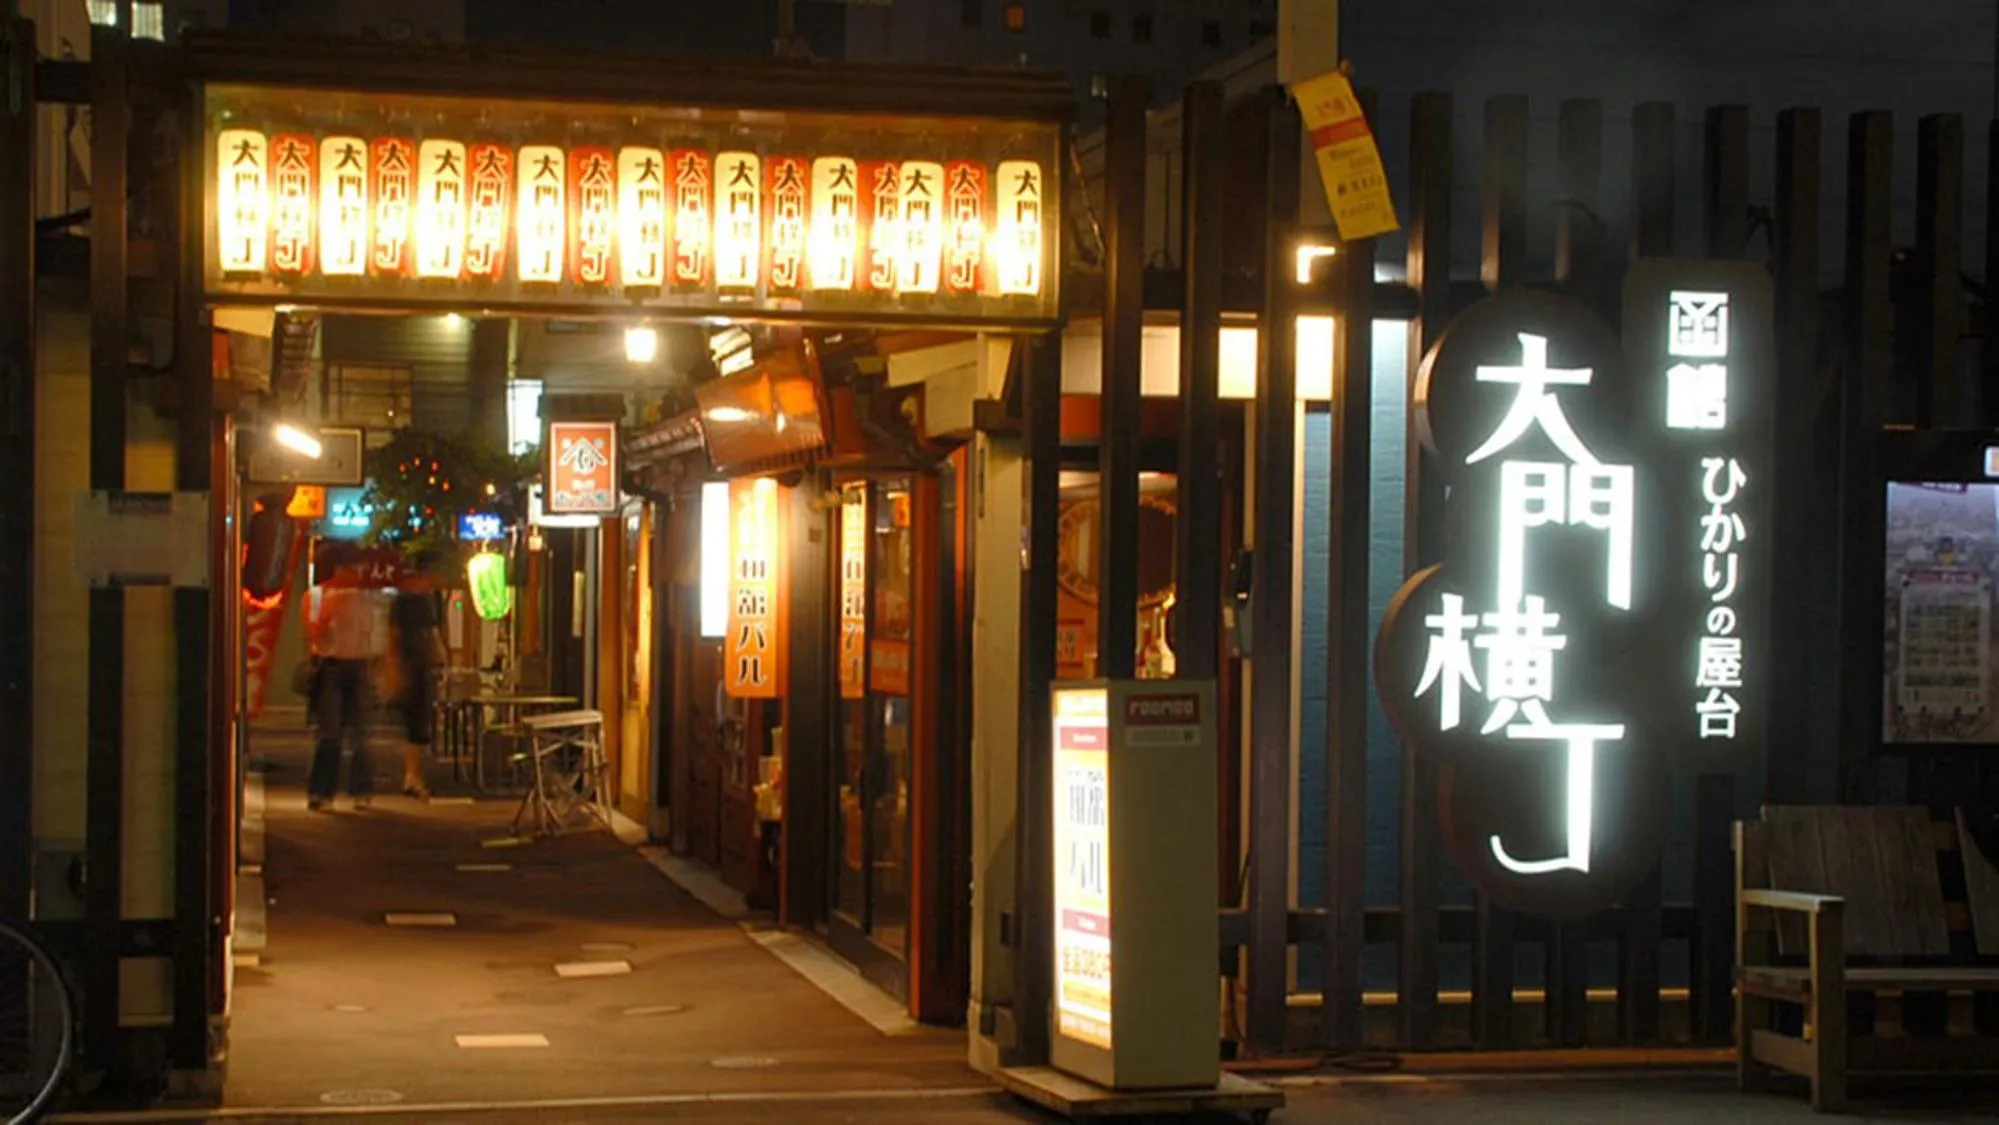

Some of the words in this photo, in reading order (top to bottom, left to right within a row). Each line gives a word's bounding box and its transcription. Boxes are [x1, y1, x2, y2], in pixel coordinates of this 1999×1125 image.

[232, 138, 261, 264] 大門丁
[278, 142, 307, 267] 大門丁
[334, 143, 363, 266] 大門丁
[377, 143, 406, 269] 大門丁
[431, 148, 462, 269] 大門丁
[470, 150, 506, 271] 大門丁
[532, 155, 560, 275] 大門丁
[583, 157, 610, 280] 大門丁
[634, 157, 662, 278] 大門丁
[677, 154, 705, 279] 大門丁
[728, 160, 755, 279] 大門丁
[774, 164, 802, 285] 大門丁
[828, 163, 855, 281] 大門丁
[872, 166, 901, 287] 大門丁
[904, 168, 932, 287] 大門丁
[950, 167, 978, 286] 大門丁
[1013, 169, 1039, 288] 大門丁
[1666, 290, 1729, 429] 函館
[1413, 332, 1635, 873] 大門横丁
[1696, 456, 1747, 739] ひかりの屋台
